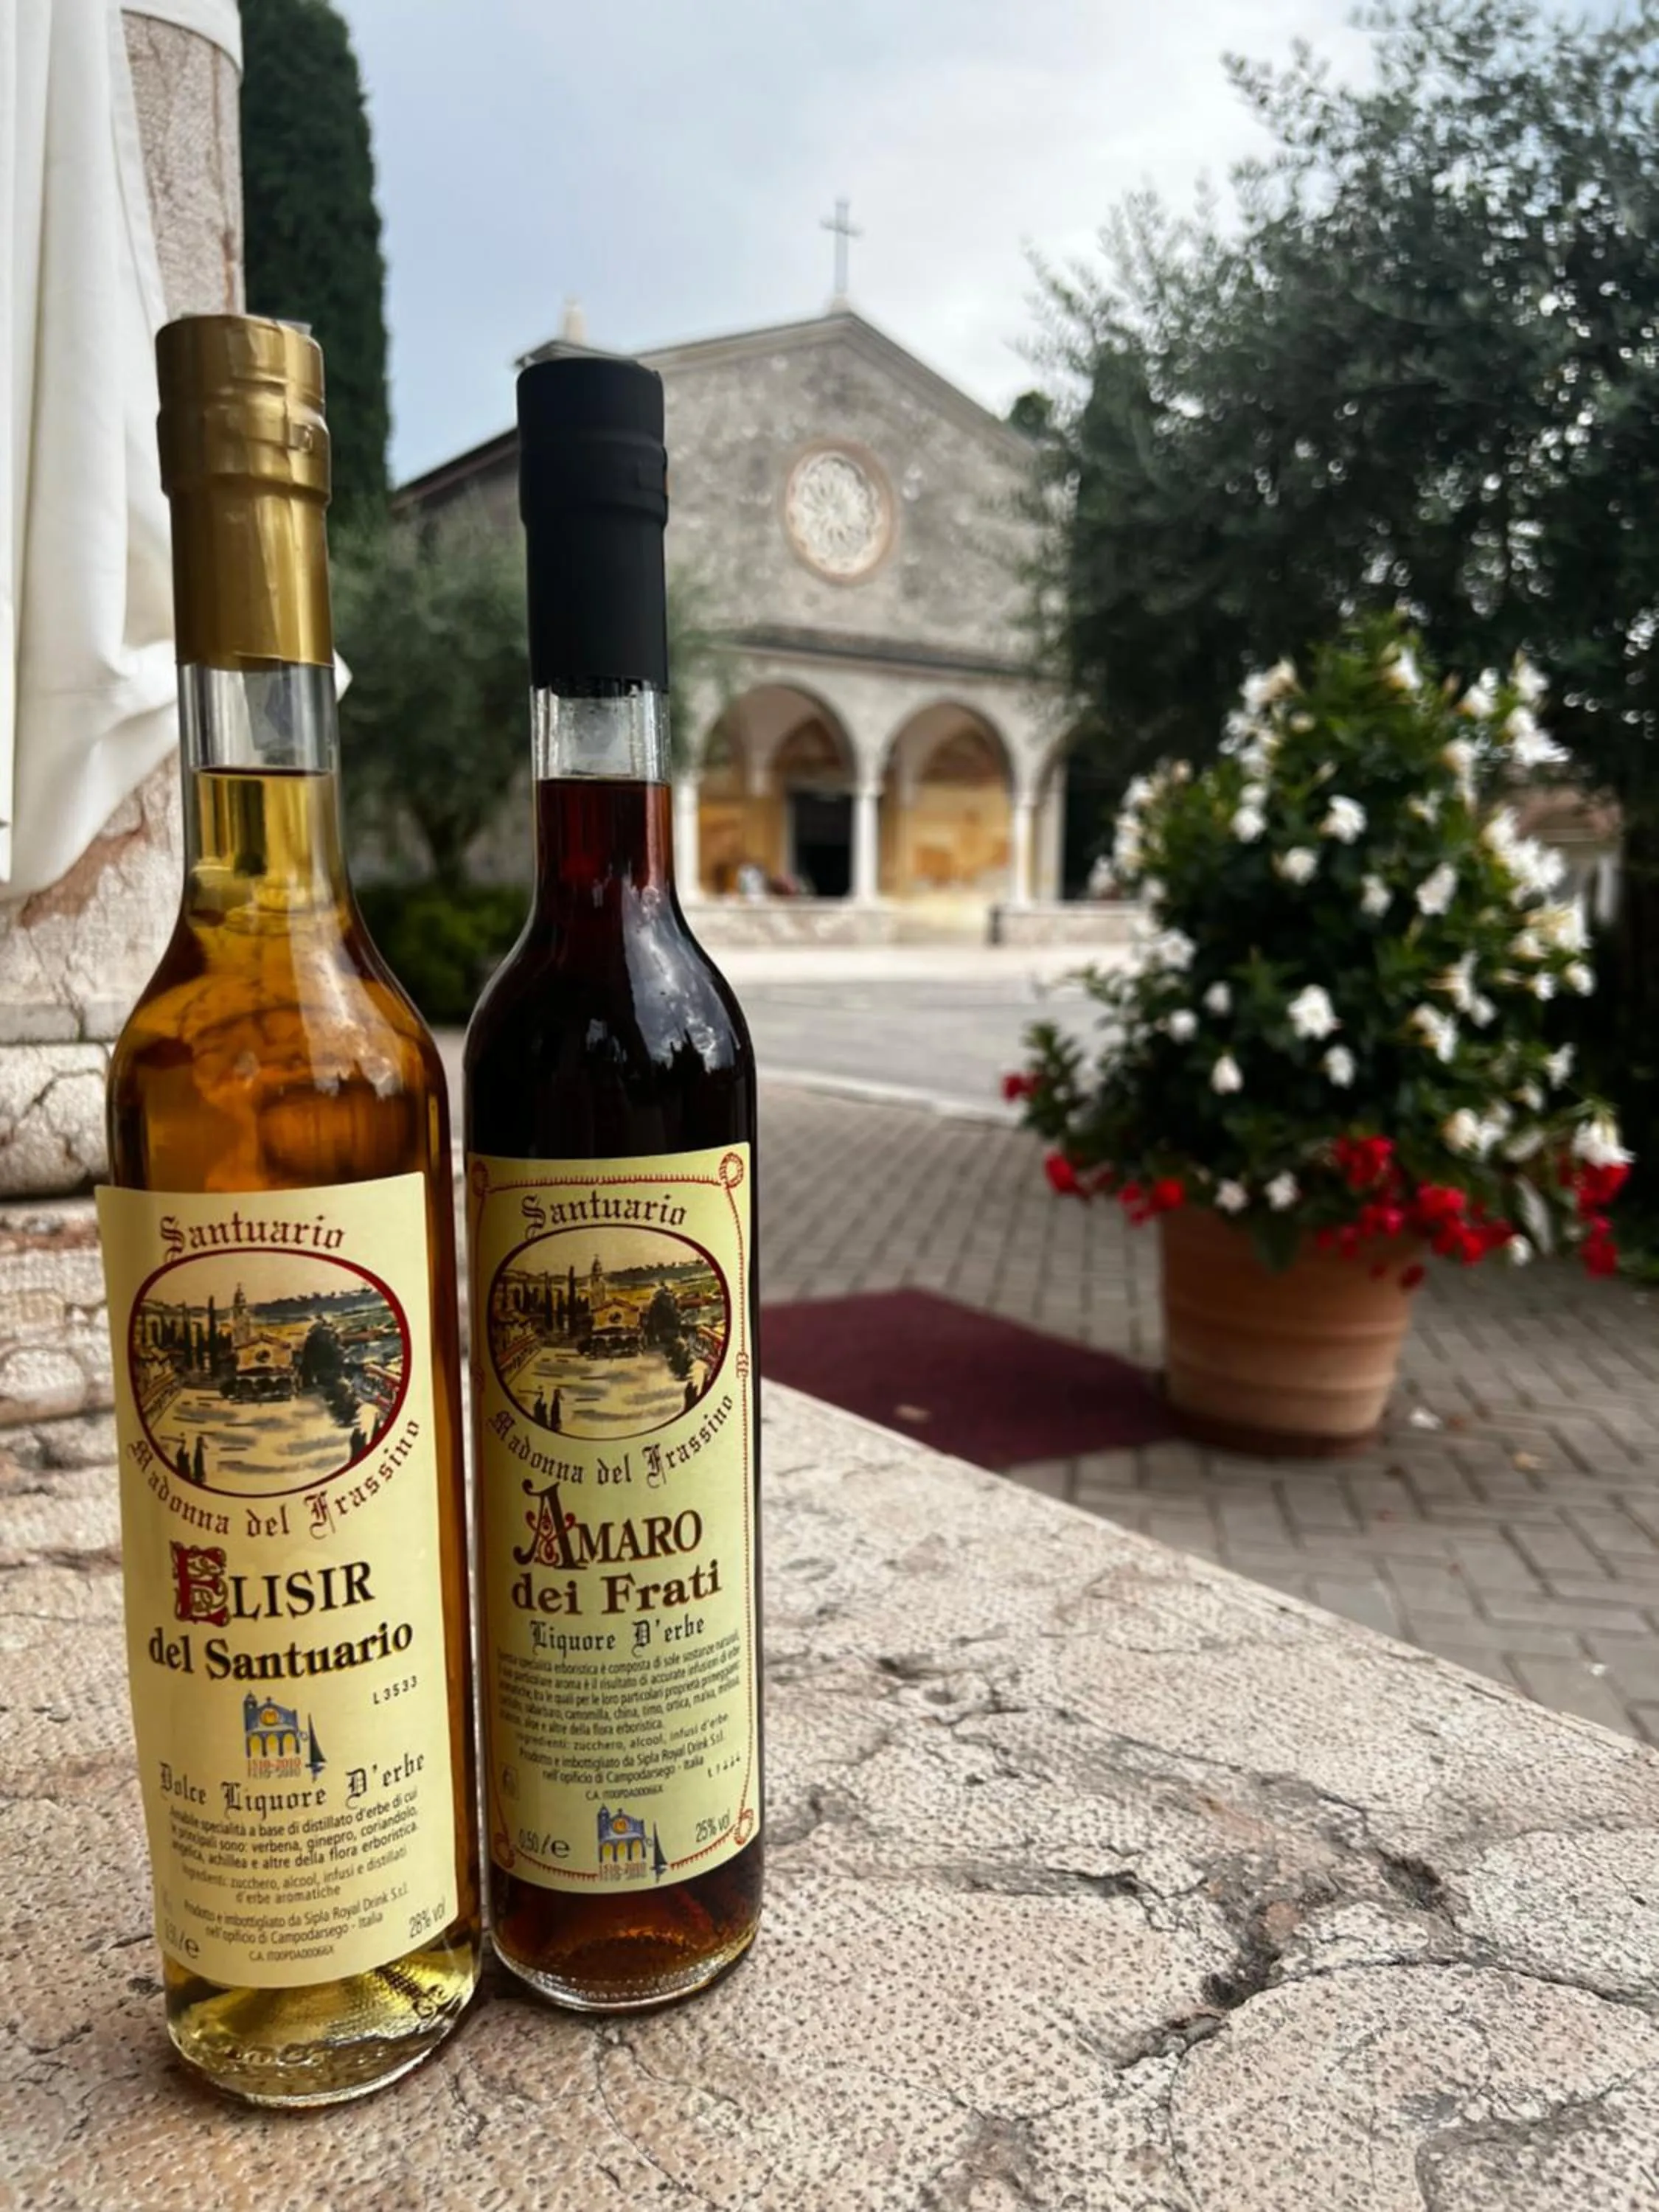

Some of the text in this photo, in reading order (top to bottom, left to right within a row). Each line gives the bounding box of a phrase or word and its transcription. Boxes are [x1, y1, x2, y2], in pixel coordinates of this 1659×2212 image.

[160, 1211, 345, 1262] Santuario
[521, 1189, 687, 1240] Santuario
[486, 1394, 733, 1489] Madonna del Frassino
[127, 1419, 420, 1540] Madonna del Frassino
[512, 1478, 703, 1570] AMARO
[170, 1540, 375, 1627] ELISIR
[511, 1558, 722, 1615] dei Frati
[150, 1621, 413, 1680] del Santuario
[529, 1613, 705, 1660] Liquore D'erbe
[608, 1659, 650, 1675] composta
[573, 1739, 626, 1753] zucchero,
[630, 1733, 667, 1750] alcool,
[622, 1755, 635, 1768] da
[637, 1750, 660, 1767] Sipla
[159, 1753, 424, 1820] Dolce Liquore D'erbe
[605, 1764, 676, 1784] Campodarsego
[249, 1826, 256, 1837] a
[259, 1823, 285, 1837] base
[288, 1820, 300, 1835] di
[302, 1813, 353, 1834] distillato
[355, 1800, 390, 1823] d'erbe
[392, 1792, 403, 1809] di
[220, 1840, 248, 1853] sono:
[251, 1839, 303, 1854] verbena,
[306, 1830, 357, 1852] ginepro,
[251, 1859, 259, 1870] e
[262, 1854, 291, 1870] altre
[295, 1851, 324, 1867] della
[329, 1844, 358, 1862] flora
[230, 1877, 280, 1891] zucchero,
[282, 1871, 320, 1889] alcool,
[324, 1863, 354, 1883] infusi
[357, 1864, 364, 1874] e
[366, 1845, 408, 1871] distillati
[275, 1884, 341, 1905] aromatiche
[288, 1913, 302, 1927] da
[304, 1910, 330, 1927] Sipla
[333, 1900, 361, 1921] Royal
[363, 1891, 389, 1913] Drink
[271, 1923, 349, 1946] Campodarsego
